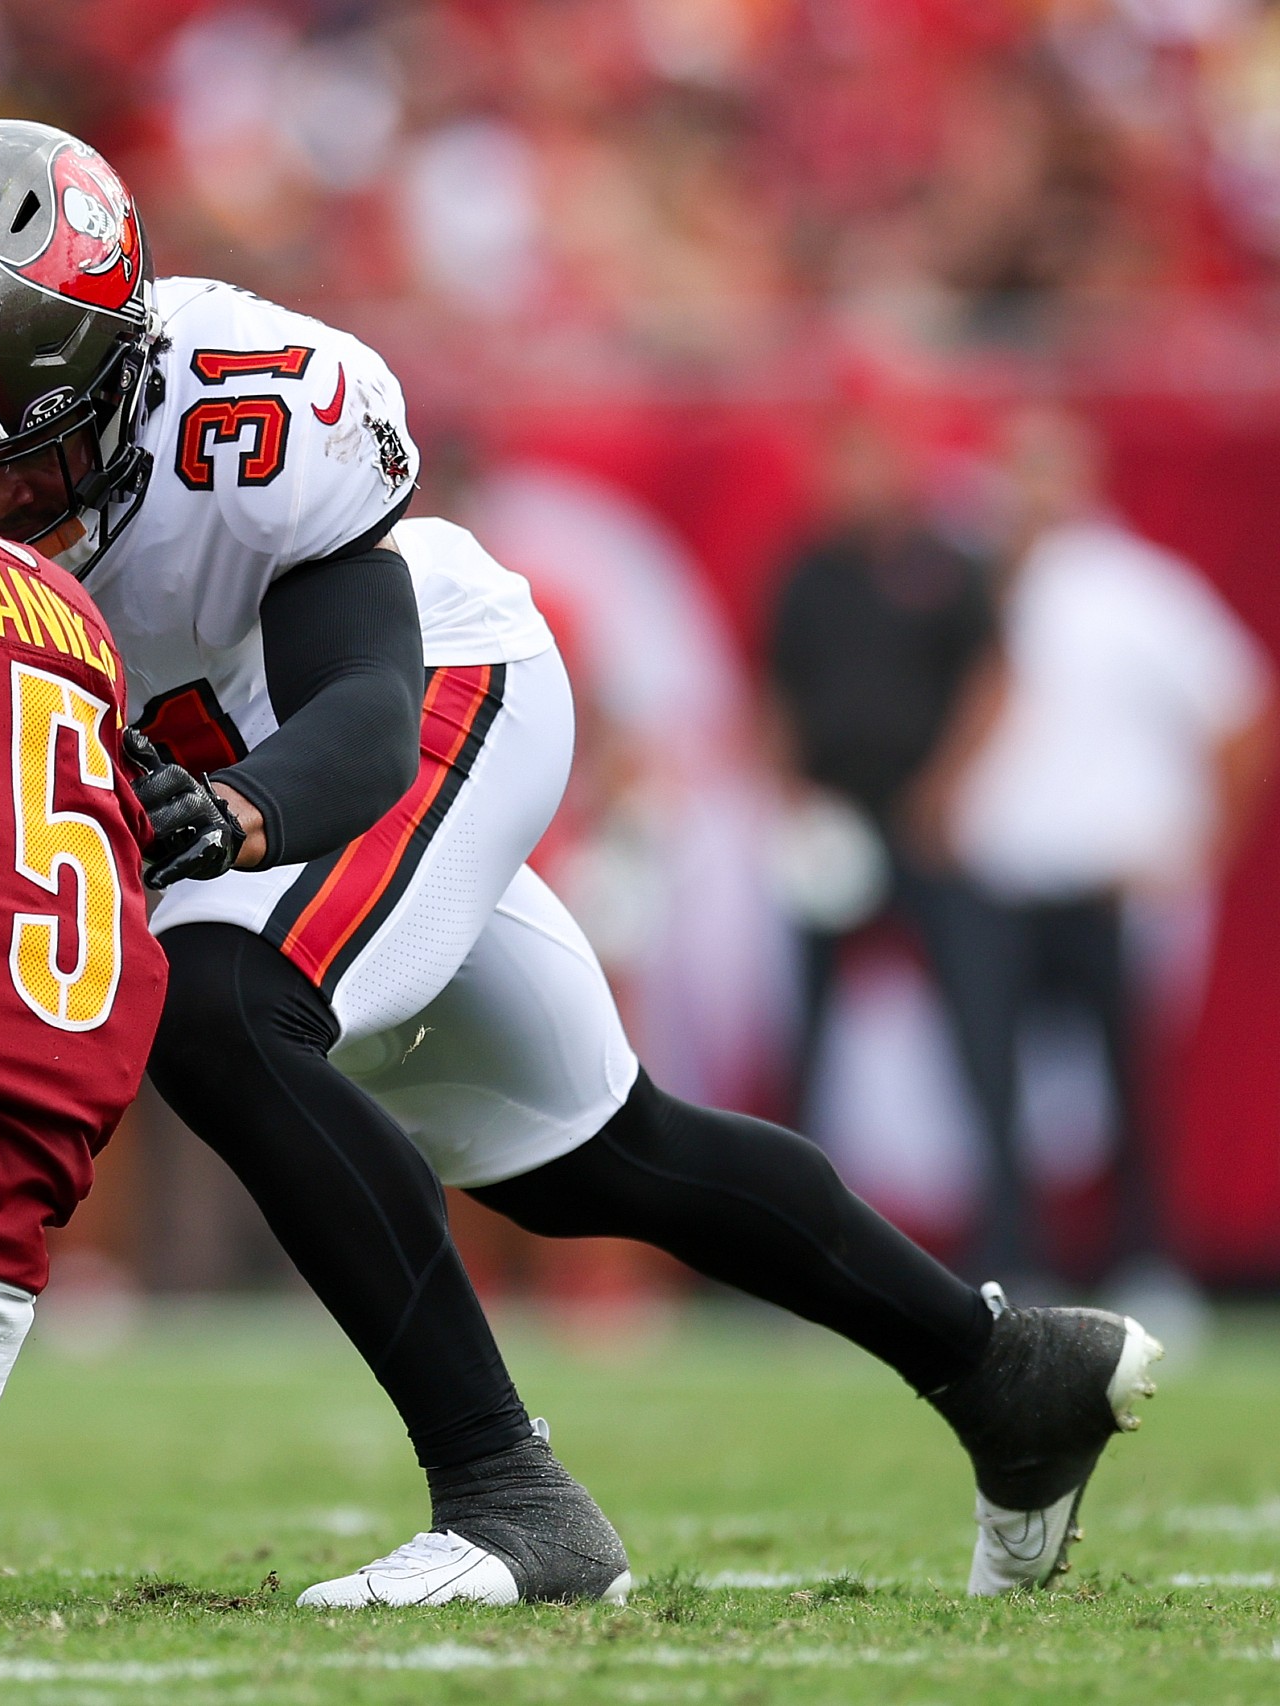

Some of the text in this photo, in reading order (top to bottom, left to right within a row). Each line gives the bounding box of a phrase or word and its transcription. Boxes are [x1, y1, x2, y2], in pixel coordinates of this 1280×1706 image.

[26, 396, 73, 429] OAKLEY
[174, 345, 316, 491] 31
[8, 659, 122, 1032] 5
